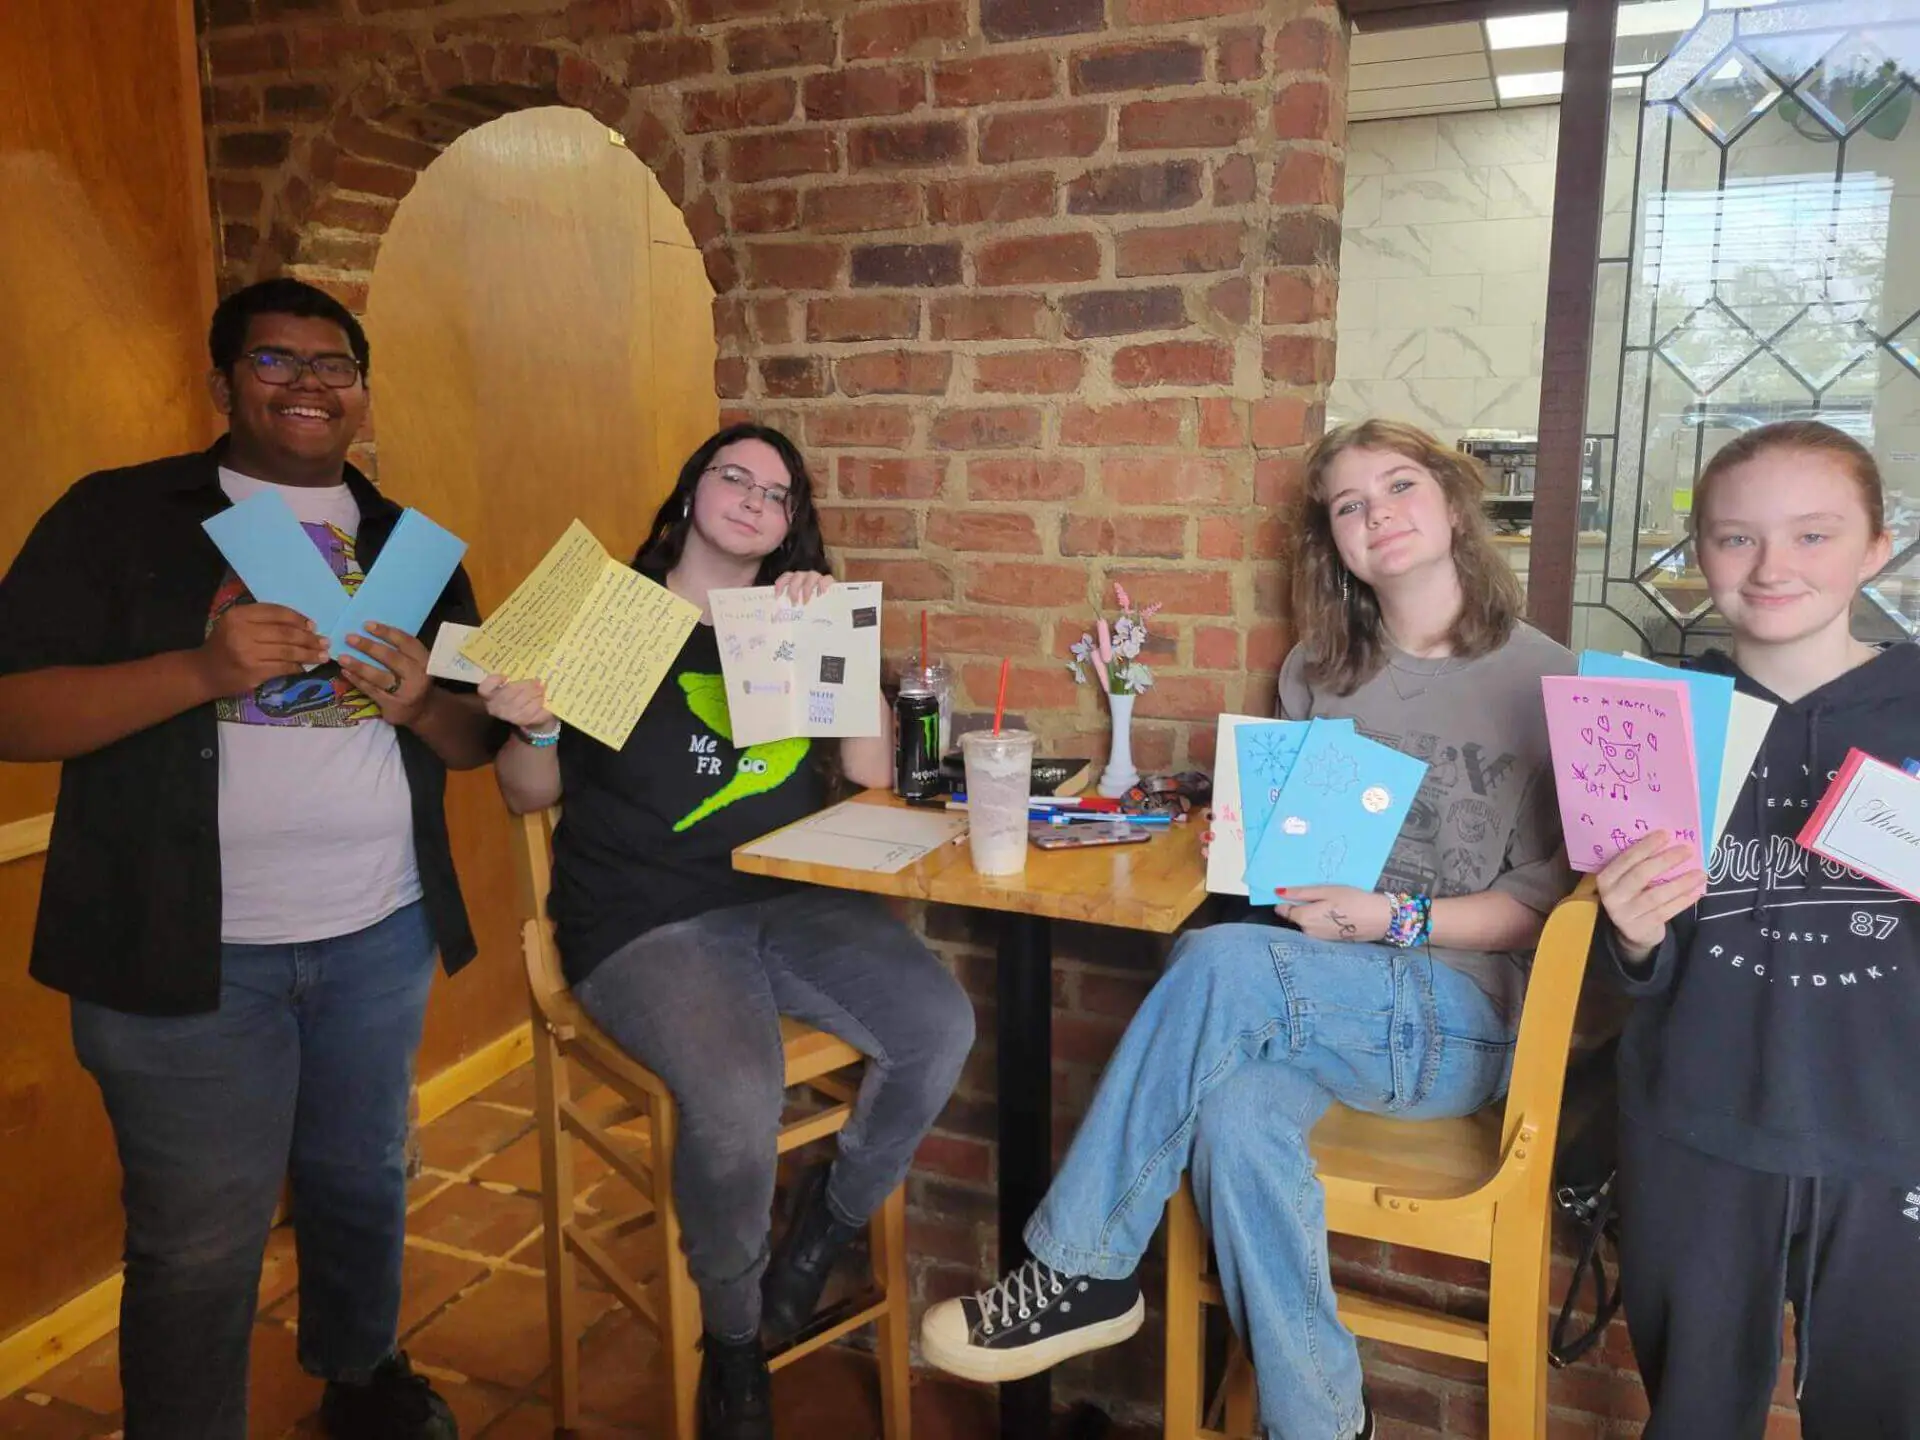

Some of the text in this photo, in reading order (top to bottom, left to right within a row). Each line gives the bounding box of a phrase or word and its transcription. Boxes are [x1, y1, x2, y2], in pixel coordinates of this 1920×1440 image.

[688, 734, 718, 754] Me
[695, 756, 723, 776] FR
[1767, 797, 1821, 808] EAS
[1760, 927, 1830, 944] COAST
[1849, 911, 1899, 940] 87
